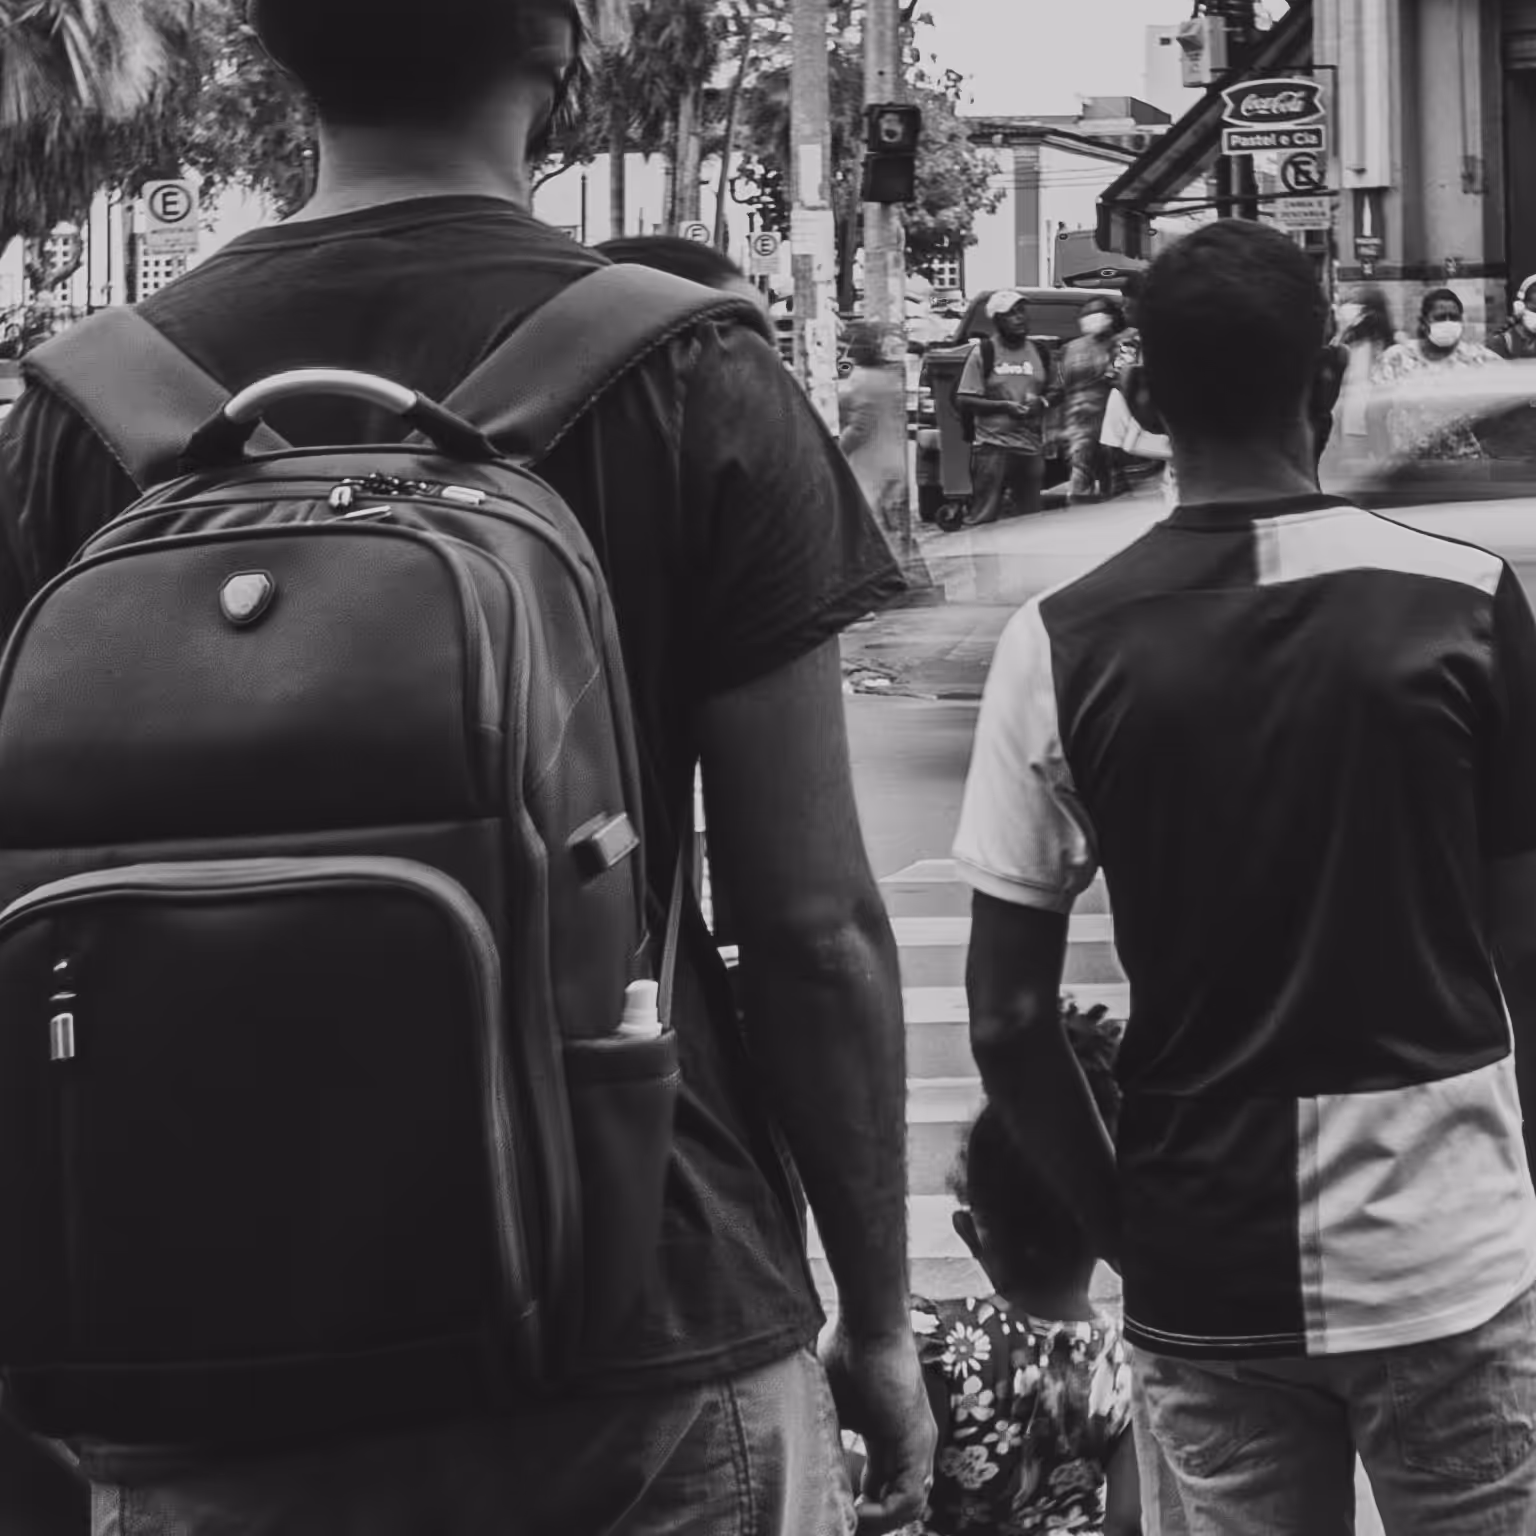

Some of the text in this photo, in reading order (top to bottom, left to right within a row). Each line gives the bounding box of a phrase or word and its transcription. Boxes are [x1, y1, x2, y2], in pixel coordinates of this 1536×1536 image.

[1230, 133, 1277, 147] Pastel
[1279, 135, 1290, 146] e
[162, 191, 180, 216] E
[761, 237, 771, 253] E
